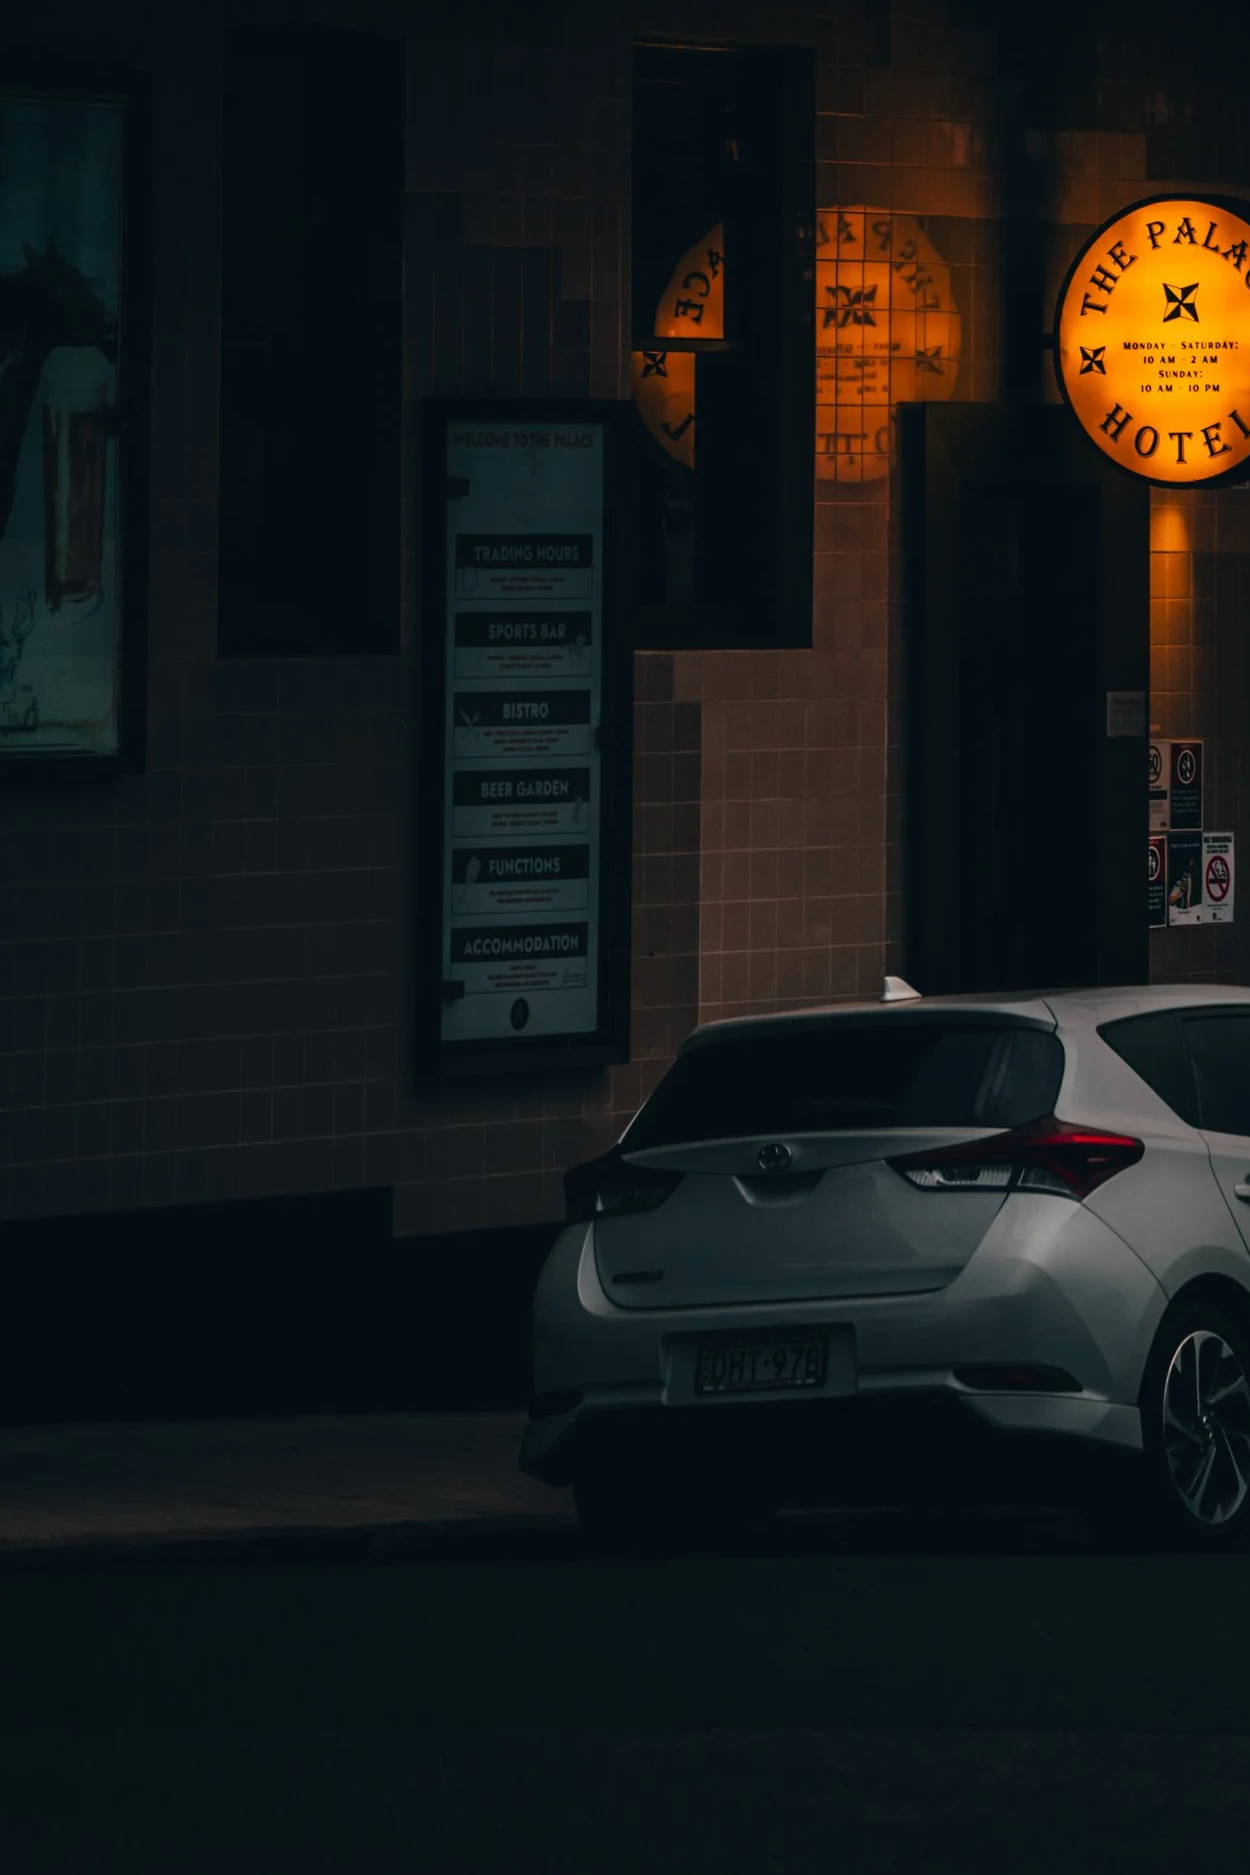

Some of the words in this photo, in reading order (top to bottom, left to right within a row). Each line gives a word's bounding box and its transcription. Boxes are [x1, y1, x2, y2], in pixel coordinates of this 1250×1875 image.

[1080, 240, 1138, 317] THE
[1143, 356, 1155, 364] 10
[1160, 356, 1176, 364] AM
[1190, 356, 1197, 364] 2
[1202, 355, 1218, 364] AM
[1205, 384, 1220, 392] PM
[453, 432, 510, 448] WELCOME
[512, 432, 528, 448] TO
[530, 433, 551, 448] THE
[554, 433, 594, 448] PALACE
[474, 546, 533, 561] TRADING
[536, 545, 579, 561] HOURS
[488, 623, 537, 640] SPORTS
[540, 623, 565, 639] BAR
[503, 702, 549, 719] BISTRO
[481, 781, 513, 798] BEER
[517, 780, 568, 797] GARDEN
[489, 857, 560, 875] FUNCTIONS
[463, 934, 579, 955] ACCOMMODATION
